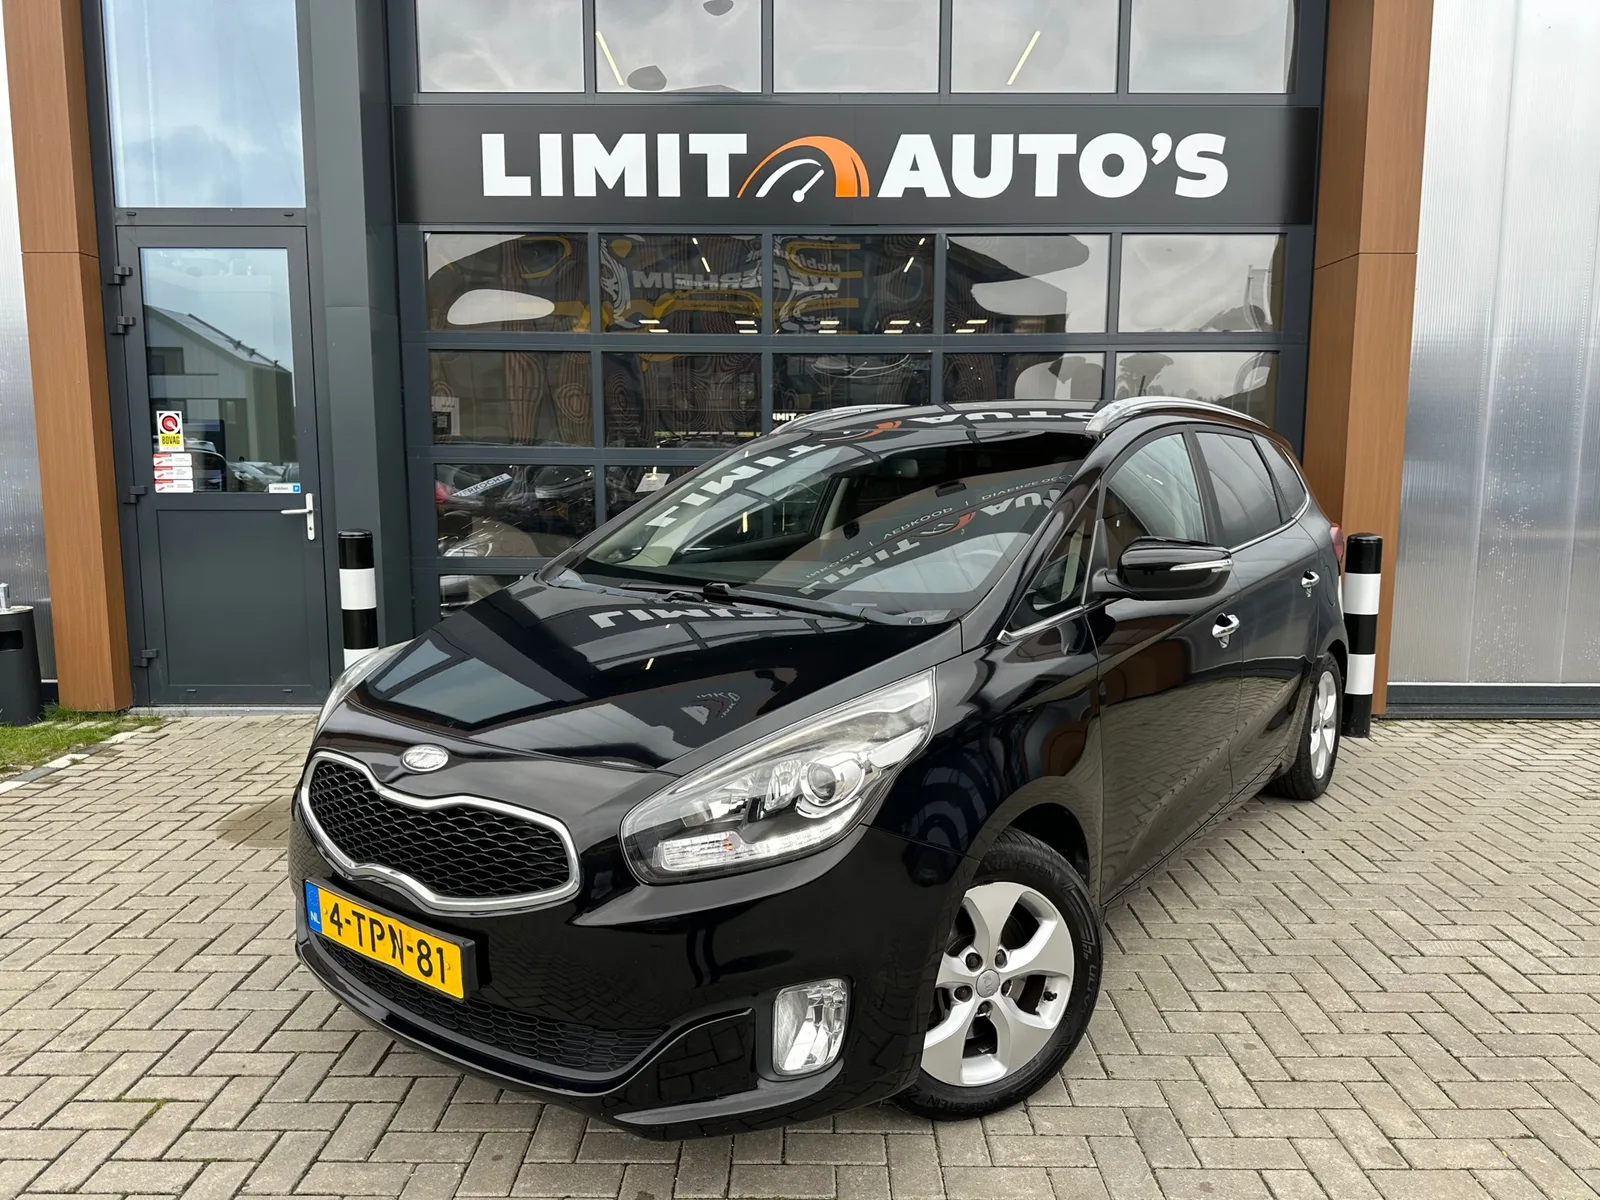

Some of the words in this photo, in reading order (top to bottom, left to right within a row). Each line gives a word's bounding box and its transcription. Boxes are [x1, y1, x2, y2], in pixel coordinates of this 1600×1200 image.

[481, 132, 747, 198] LIMIT
[877, 132, 1229, 199] AUTO'S
[161, 435, 181, 445] BOVAG
[310, 912, 320, 924] NL
[329, 903, 446, 984] 4-TPN-81
